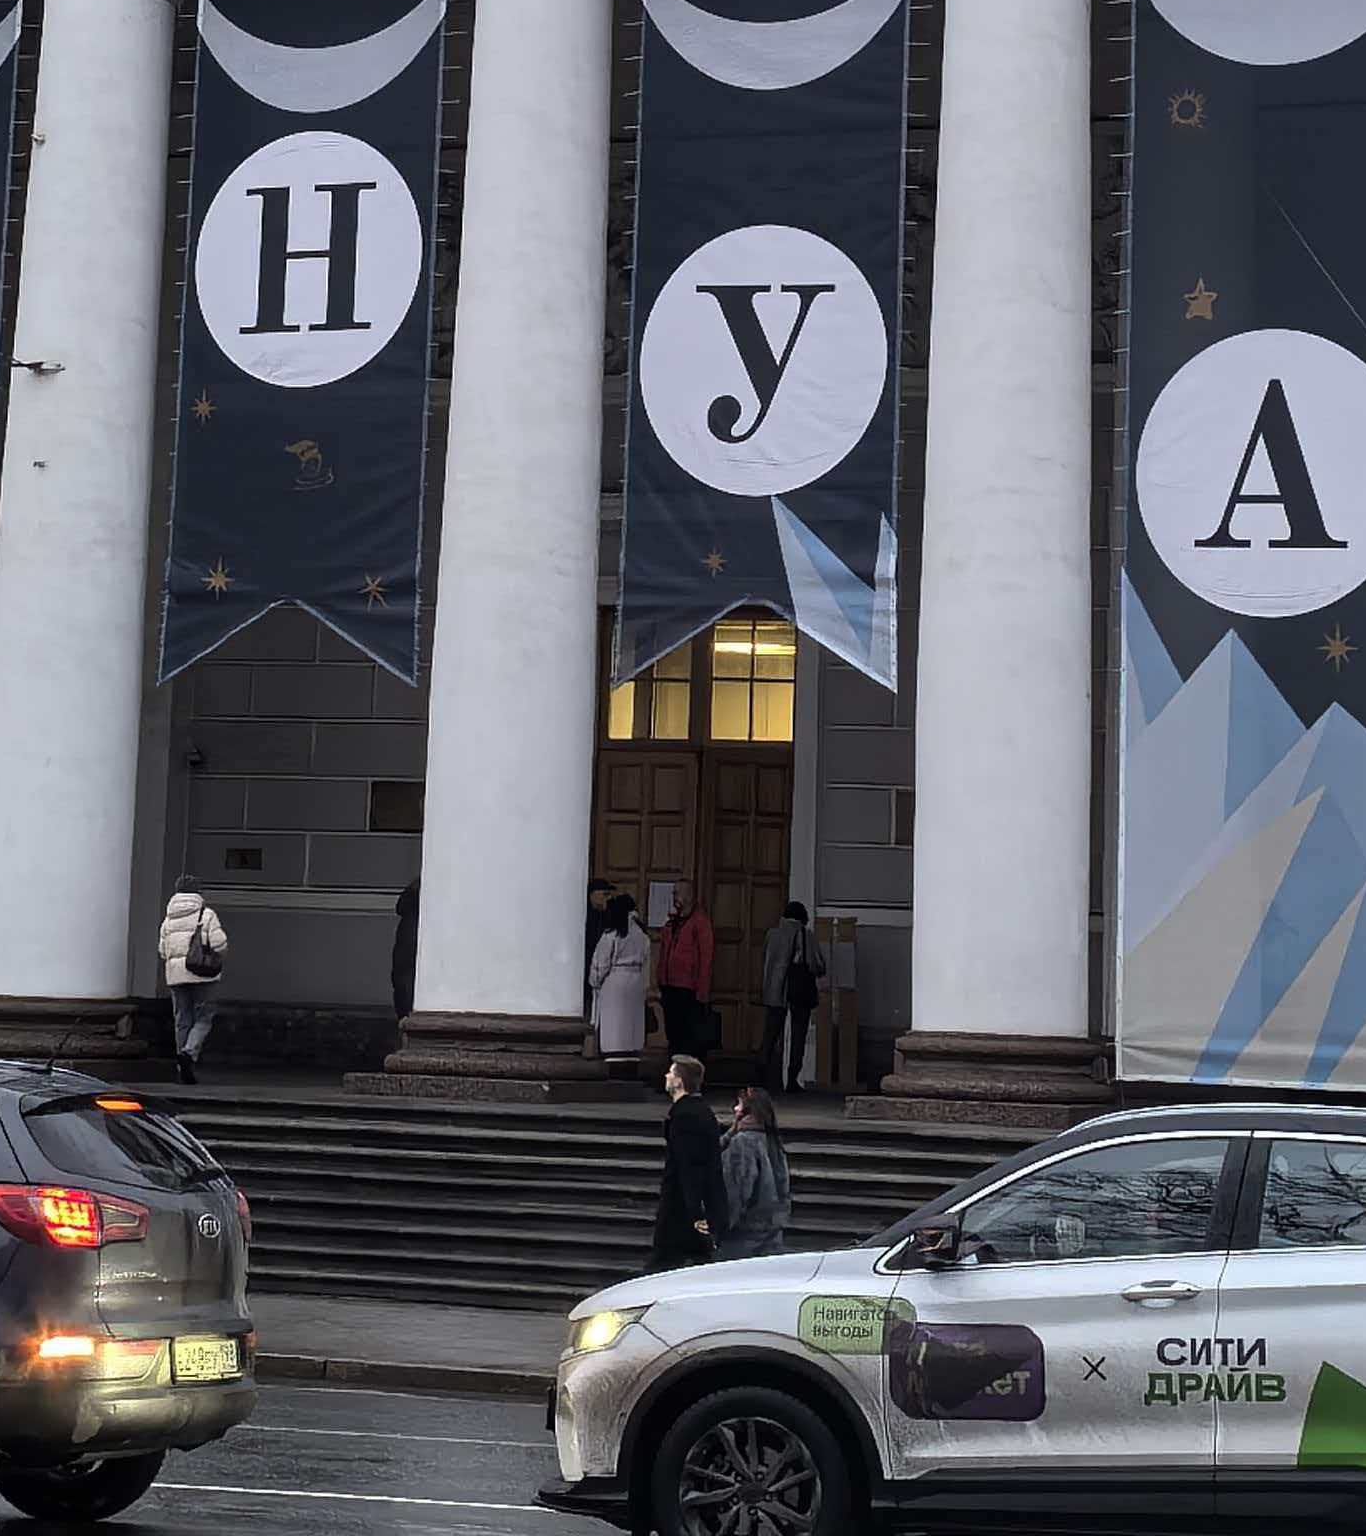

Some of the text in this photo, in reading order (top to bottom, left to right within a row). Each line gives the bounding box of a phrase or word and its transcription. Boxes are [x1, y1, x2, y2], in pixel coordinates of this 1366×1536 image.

[238, 181, 377, 334] Н
[695, 284, 835, 444] У
[1193, 378, 1349, 549] А
[811, 1325, 874, 1340] выгоды
[1156, 1337, 1267, 1367] СИТИ
[1143, 1366, 1288, 1407] ДРАЙВ
